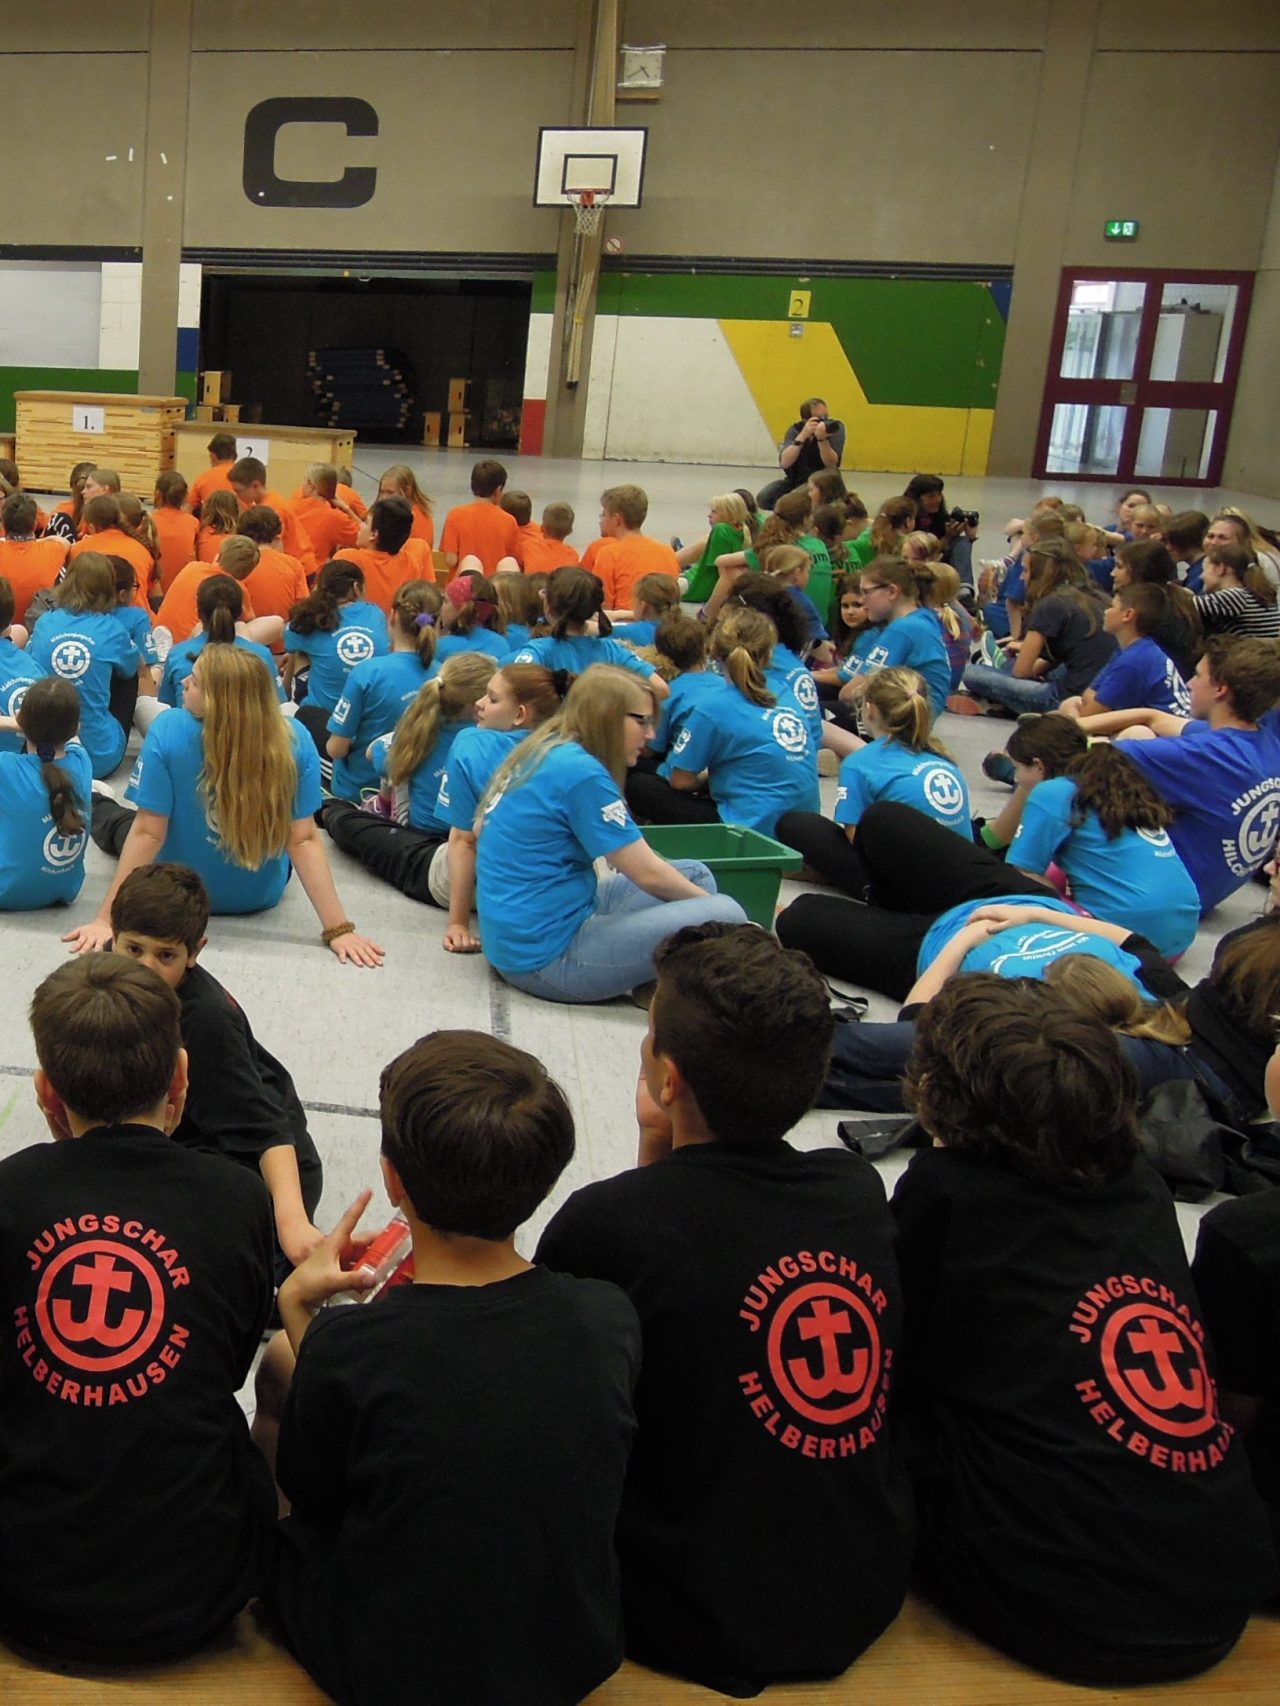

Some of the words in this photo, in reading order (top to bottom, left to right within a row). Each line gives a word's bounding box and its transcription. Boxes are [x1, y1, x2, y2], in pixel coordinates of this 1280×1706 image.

[241, 96, 380, 209] C
[791, 298, 804, 316] 2
[26, 1213, 191, 1289] JUNGSCHAR
[739, 1250, 888, 1332] JUNGSCHAR
[14, 1305, 191, 1407] HELBERHAUSEN
